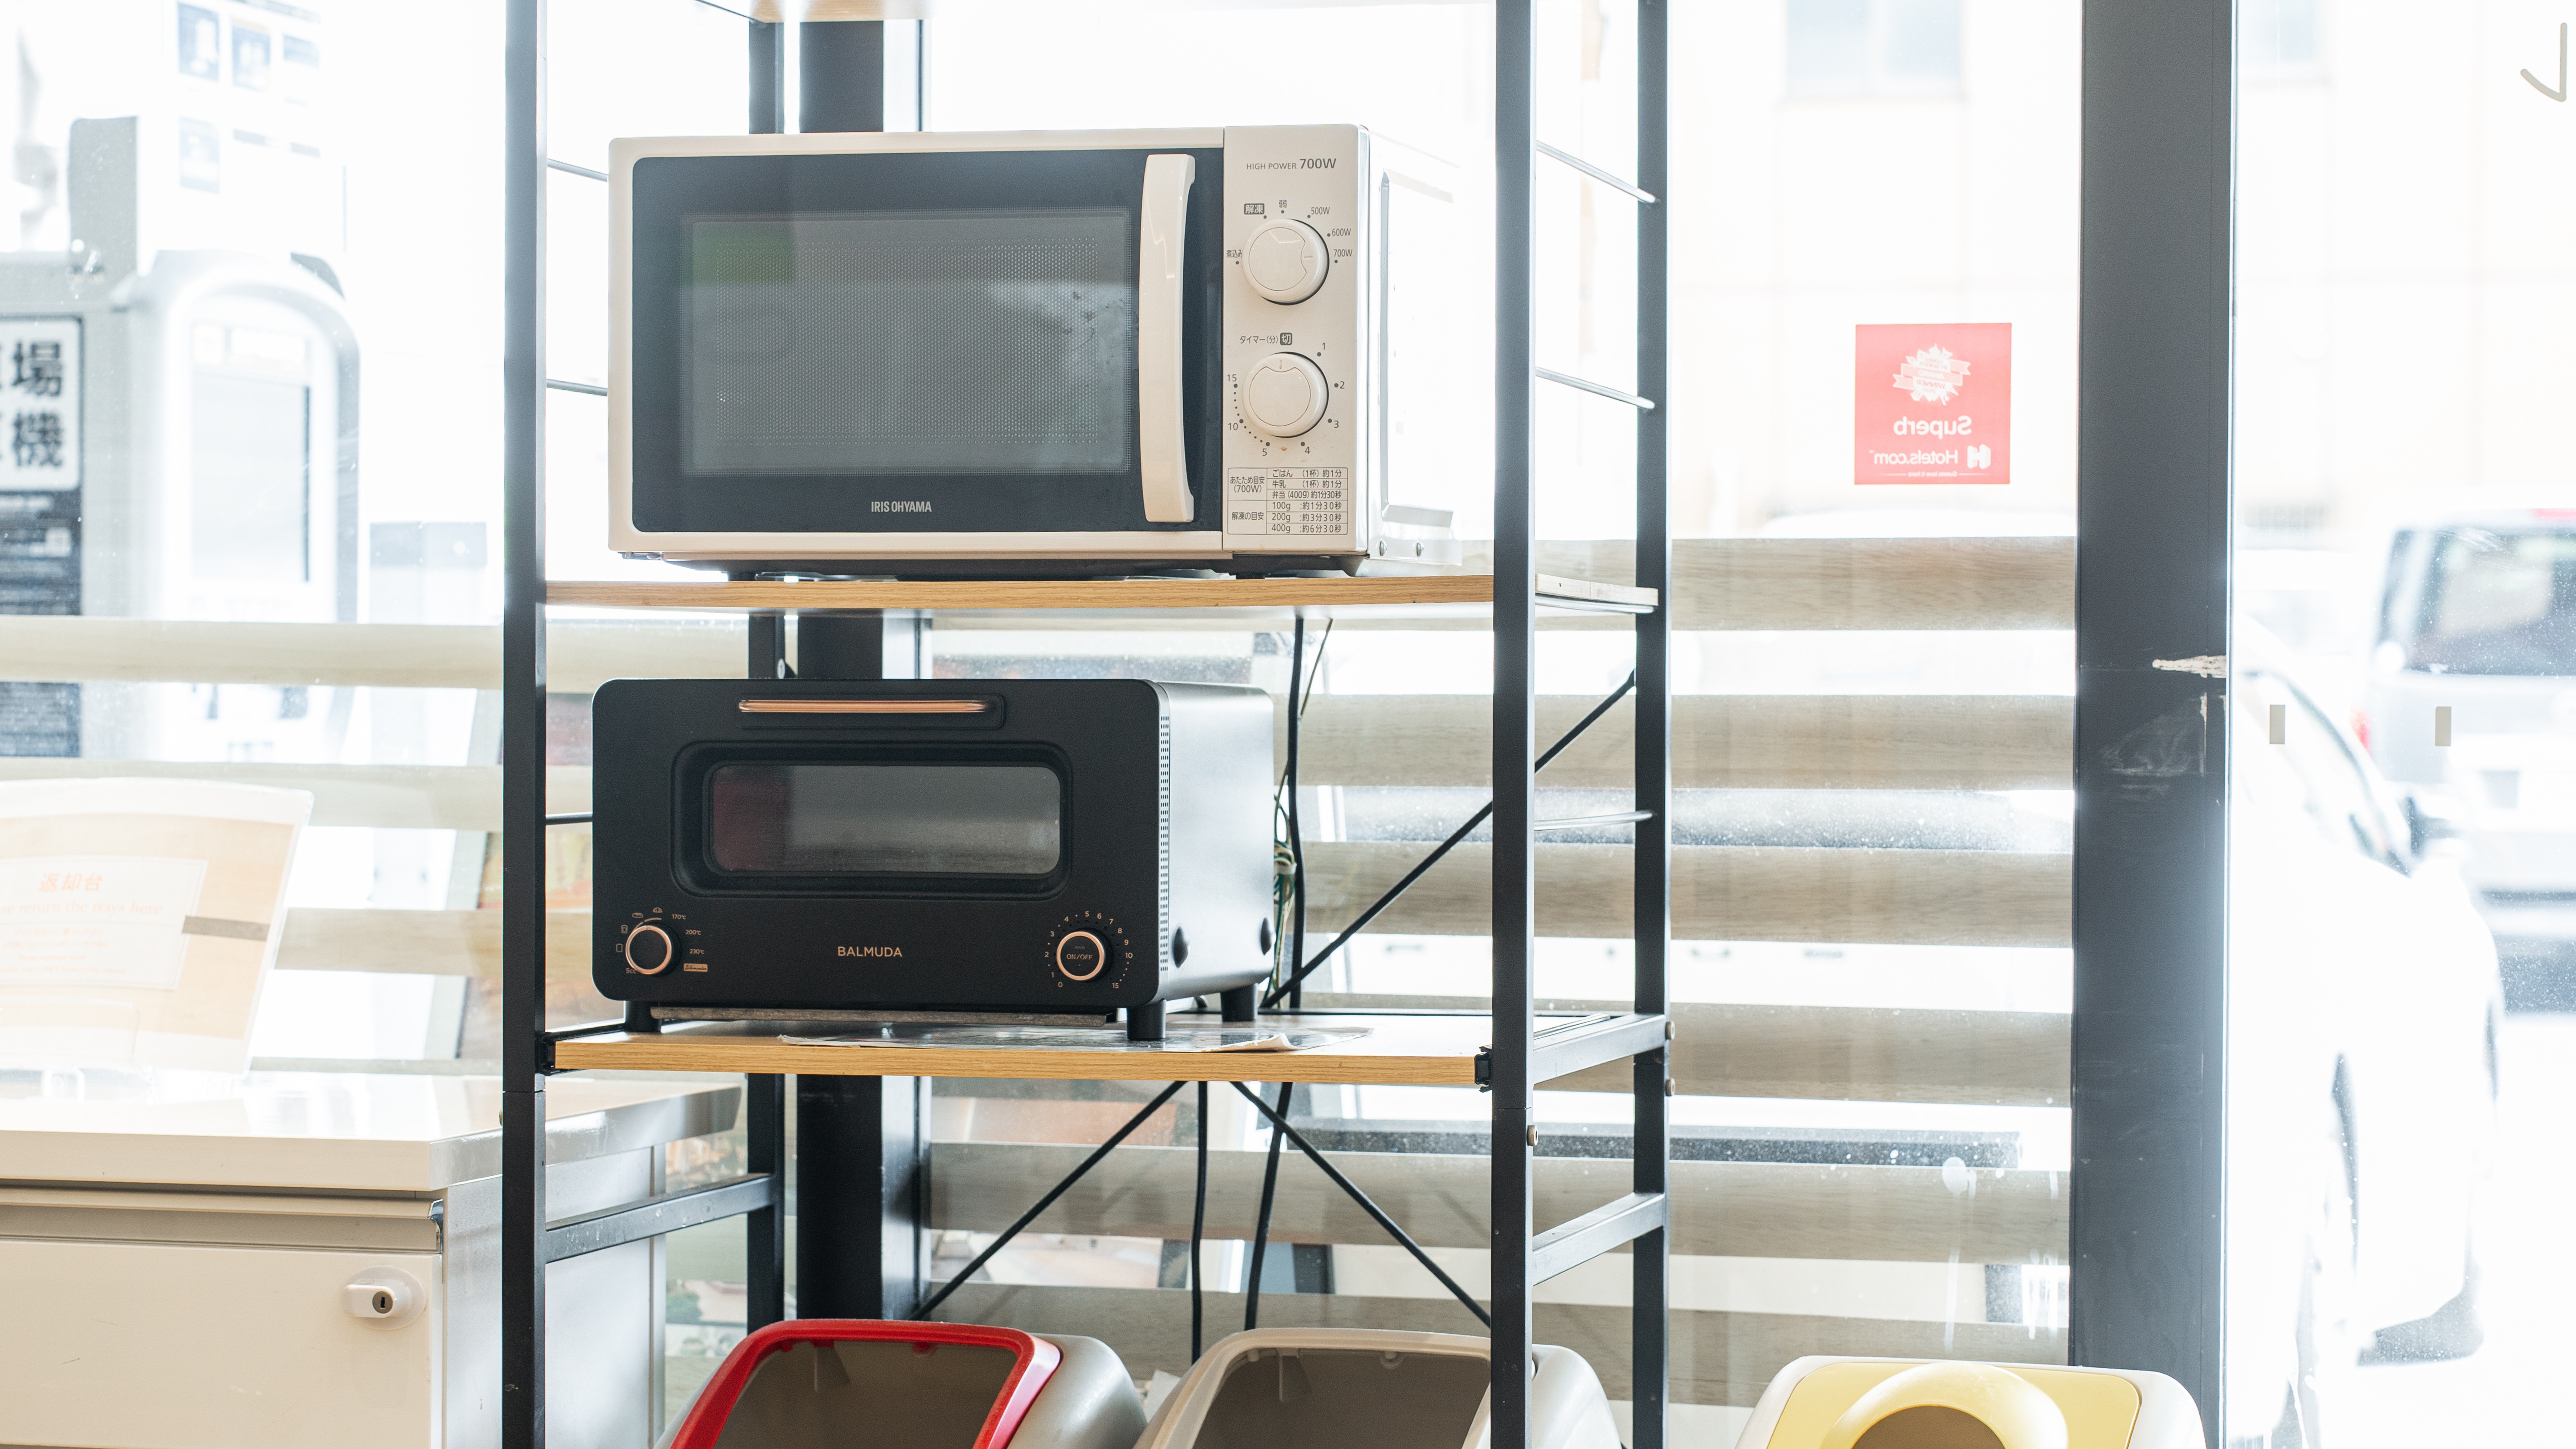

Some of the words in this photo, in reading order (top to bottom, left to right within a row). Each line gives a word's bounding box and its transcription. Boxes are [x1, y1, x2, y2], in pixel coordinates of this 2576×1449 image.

[1299, 158, 1336, 169] 700W
[1279, 199, 1287, 208] 弱
[1245, 204, 1264, 214] 解凍
[1332, 228, 1351, 236] 600W
[1333, 249, 1353, 257] 700W
[1240, 335, 1278, 344] タイマー(分)
[1281, 333, 1291, 344] 切
[0, 341, 62, 397] 場
[0, 413, 63, 467] 機
[1272, 469, 1293, 477] ごはん
[1302, 469, 1319, 478] (1杯)
[1322, 469, 1342, 477] 約1分
[1272, 480, 1286, 488] 牛乳
[1302, 480, 1319, 488] (1杯)
[1322, 480, 1342, 488] 約1分
[1234, 485, 1262, 493] (700W)
[1272, 490, 1285, 499] 弁当
[1288, 490, 1309, 499] (400g)
[1311, 490, 1342, 499] 約1分30秒
[871, 501, 890, 512] IRIS
[891, 501, 932, 512] OHYAMA
[1272, 502, 1291, 510] 100g
[1272, 513, 1291, 522] 200g
[1271, 524, 1291, 533] 400g
[39, 872, 103, 892] 返却台
[19, 902, 61, 915] return
[66, 899, 88, 913] the
[92, 903, 125, 917] trays
[130, 900, 163, 915] here
[838, 946, 902, 957] BALMUDA
